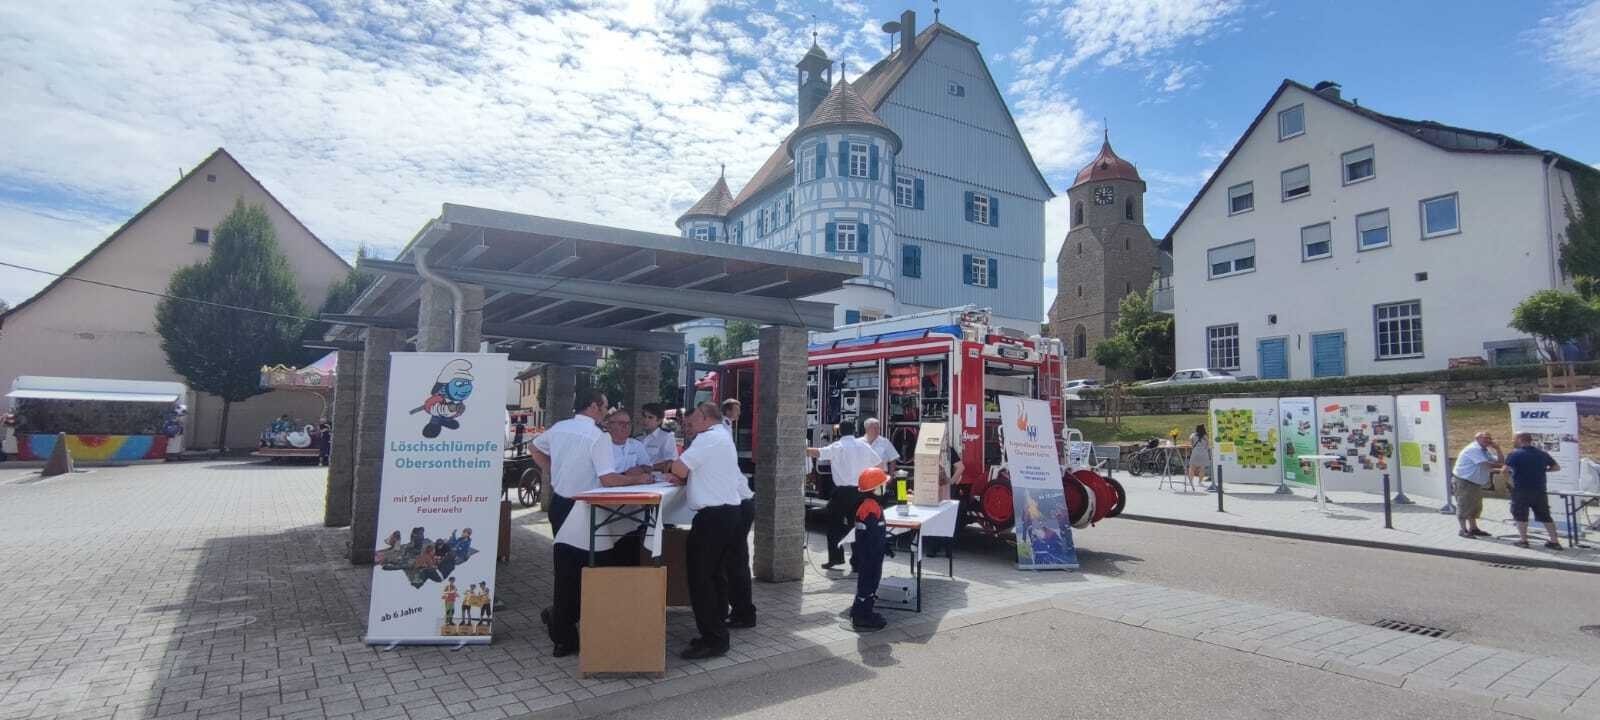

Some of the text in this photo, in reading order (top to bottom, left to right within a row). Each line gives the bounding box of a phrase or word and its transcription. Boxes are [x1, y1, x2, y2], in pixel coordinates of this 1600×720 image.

[1520, 410, 1551, 419] VdK
[390, 440, 498, 454] Löschschlümpfe
[395, 458, 491, 469] Obersontheim
[393, 494, 408, 503] mit
[409, 494, 431, 504] Spiel
[432, 494, 449, 503] und
[451, 494, 473, 504] Spaß
[416, 506, 463, 514] Feuerwehr
[380, 606, 423, 622] ab 6 Jahre
